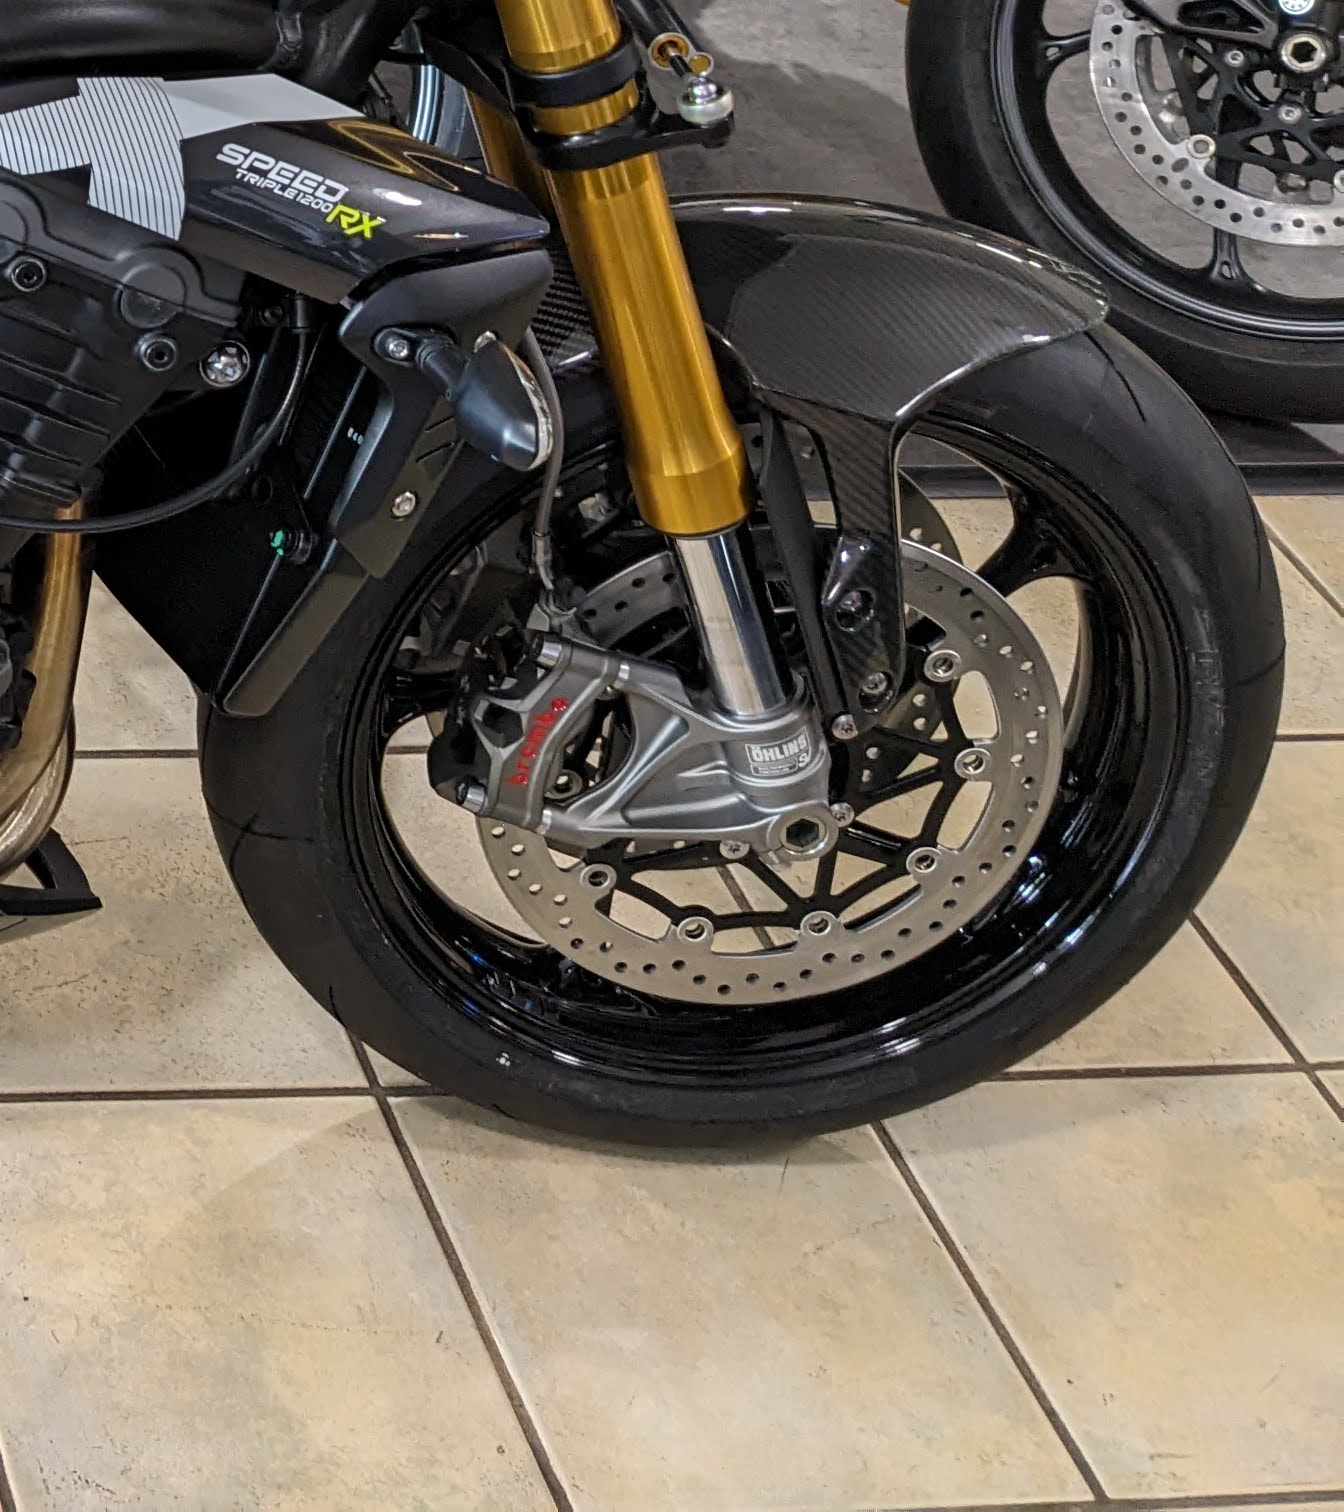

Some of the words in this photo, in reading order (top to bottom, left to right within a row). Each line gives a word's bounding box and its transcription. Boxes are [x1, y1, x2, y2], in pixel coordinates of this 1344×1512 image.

[215, 142, 349, 203] SPEED
[325, 202, 387, 239] RX
[507, 696, 568, 785] brembo
[751, 734, 808, 763] ÖHLINS
